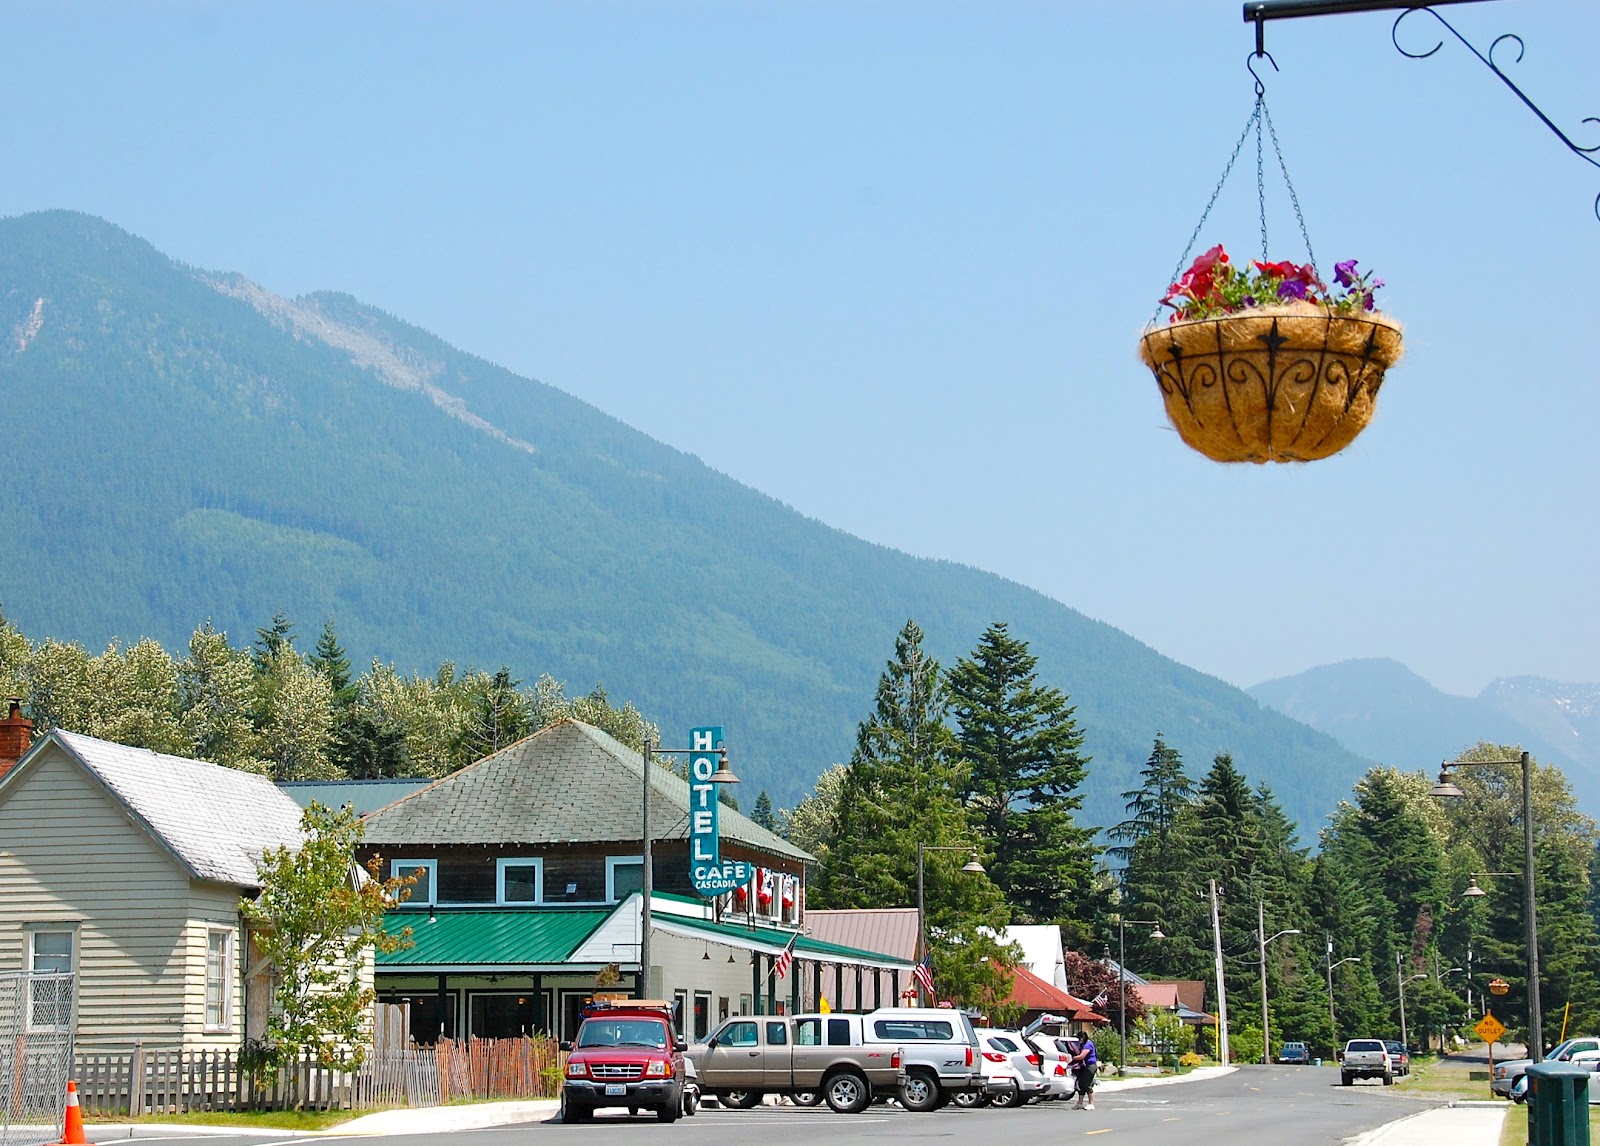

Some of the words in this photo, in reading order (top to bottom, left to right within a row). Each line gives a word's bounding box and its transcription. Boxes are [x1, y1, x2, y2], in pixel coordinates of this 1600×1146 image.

[693, 731, 713, 860] HOTEL
[694, 865, 746, 880] CAFE
[695, 880, 737, 890] CASCADIA
